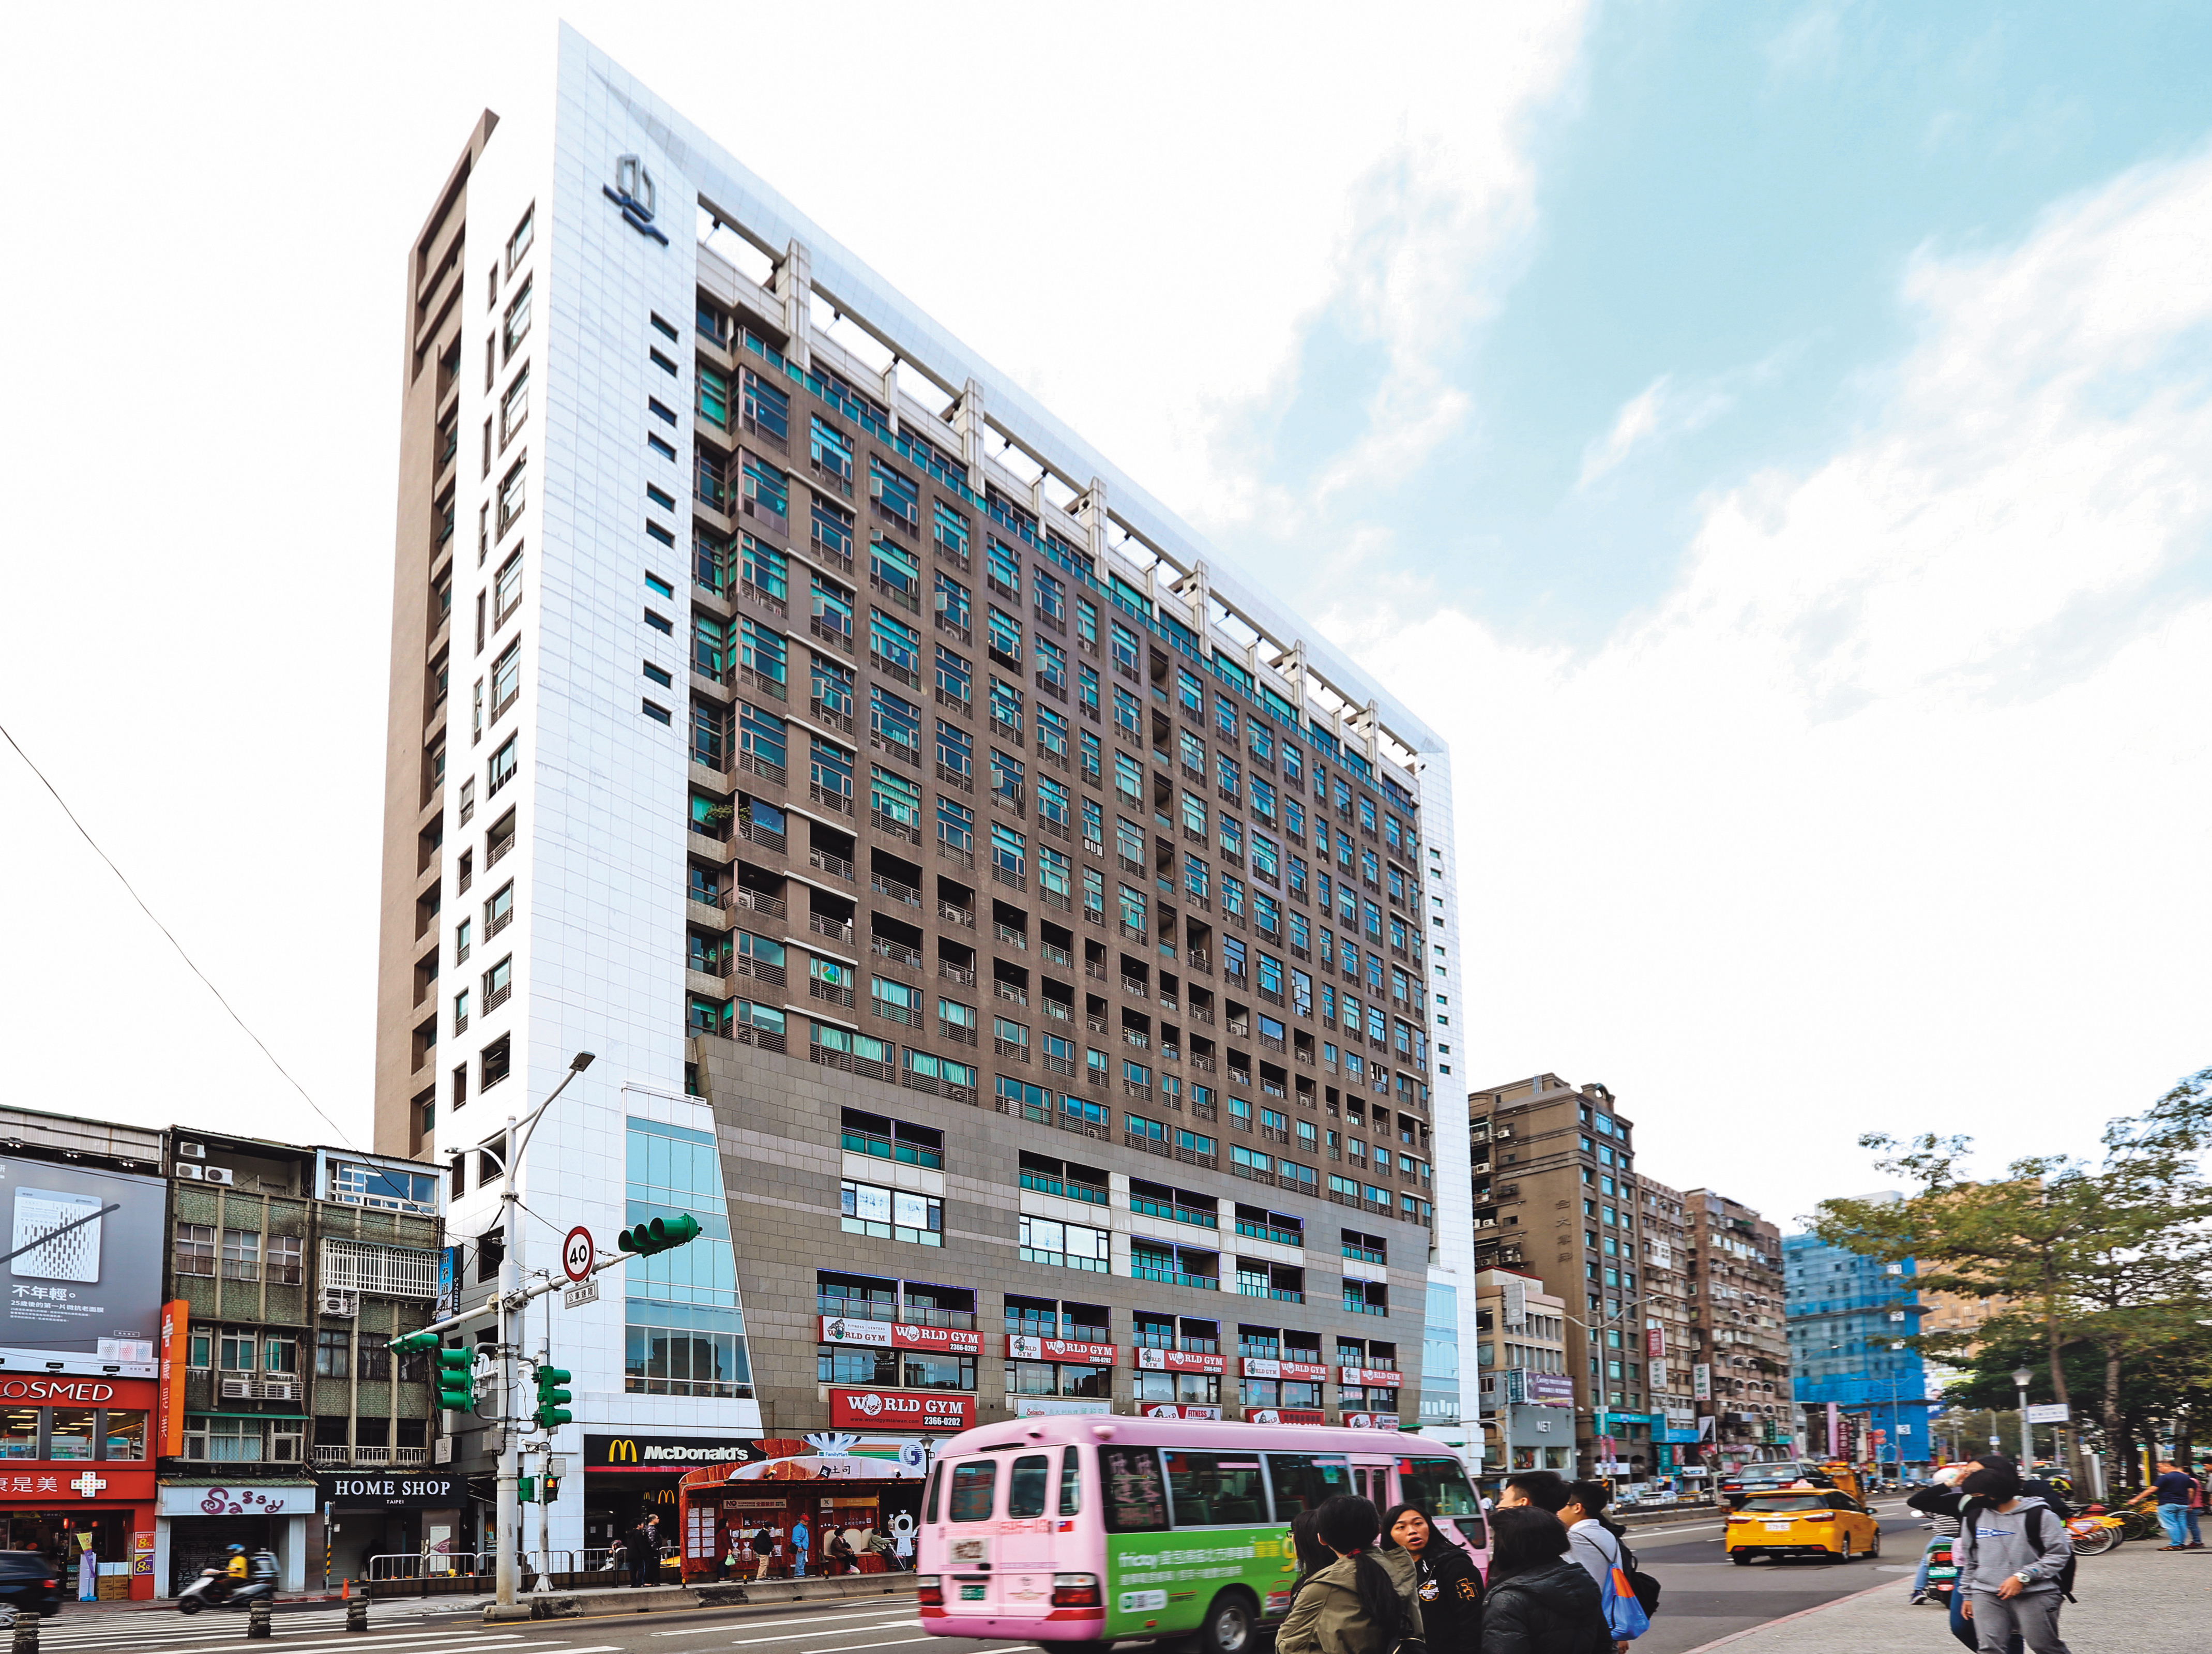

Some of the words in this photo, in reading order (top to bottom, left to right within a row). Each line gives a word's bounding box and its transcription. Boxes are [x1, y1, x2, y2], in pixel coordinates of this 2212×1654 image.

[569, 1244, 587, 1265] 40
[11, 1284, 76, 1301] 不年輕。
[568, 1287, 593, 1302] 公車速限
[10, 1300, 104, 1313] 25歲後的第一片微抗老面膜
[895, 1325, 947, 1342] WORLD
[950, 1331, 979, 1344] GYM
[950, 1344, 977, 1352] 2366-0202
[1045, 1340, 1087, 1355] WORLD
[1089, 1345, 1113, 1356] GYM
[1168, 1351, 1202, 1365] WORLD
[1204, 1356, 1223, 1365] GYM
[1281, 1362, 1309, 1374] WORLD
[1310, 1365, 1326, 1374] GYM
[1362, 1370, 1386, 1380] WORLD
[0, 1380, 113, 1401] OSMED
[160, 1359, 170, 1438] 康是美
[846, 1393, 920, 1416] WORLD
[925, 1400, 963, 1414] GYM
[924, 1416, 961, 1426] 2366-0202
[1536, 1421, 1552, 1433] NET
[644, 1446, 748, 1460] McDonald's
[830, 1465, 851, 1475] 土司
[335, 1480, 395, 1495] HOME
[402, 1480, 450, 1495] SHOP
[201, 1487, 284, 1514] Sassy
